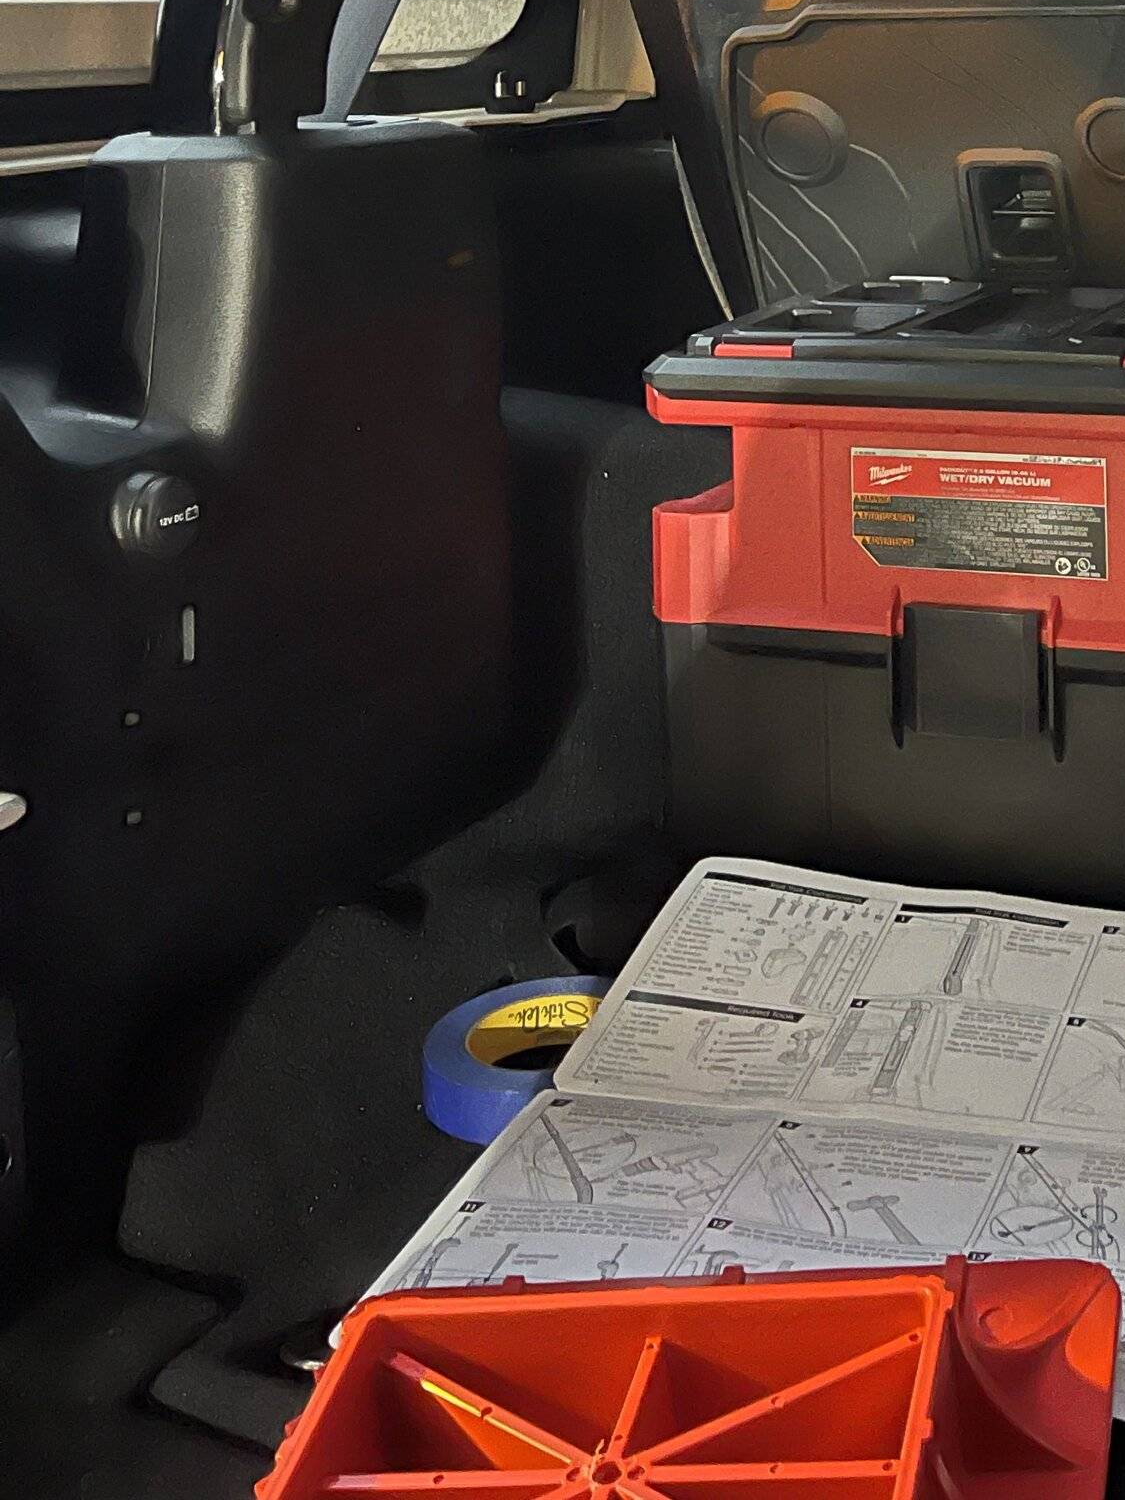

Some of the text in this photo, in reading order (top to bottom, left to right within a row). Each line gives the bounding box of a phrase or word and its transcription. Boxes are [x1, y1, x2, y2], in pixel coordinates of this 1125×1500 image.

[869, 463, 913, 482] Milwaukee
[939, 473, 1051, 488] WET/DRY VACUUM
[159, 513, 184, 526] 12V DC
